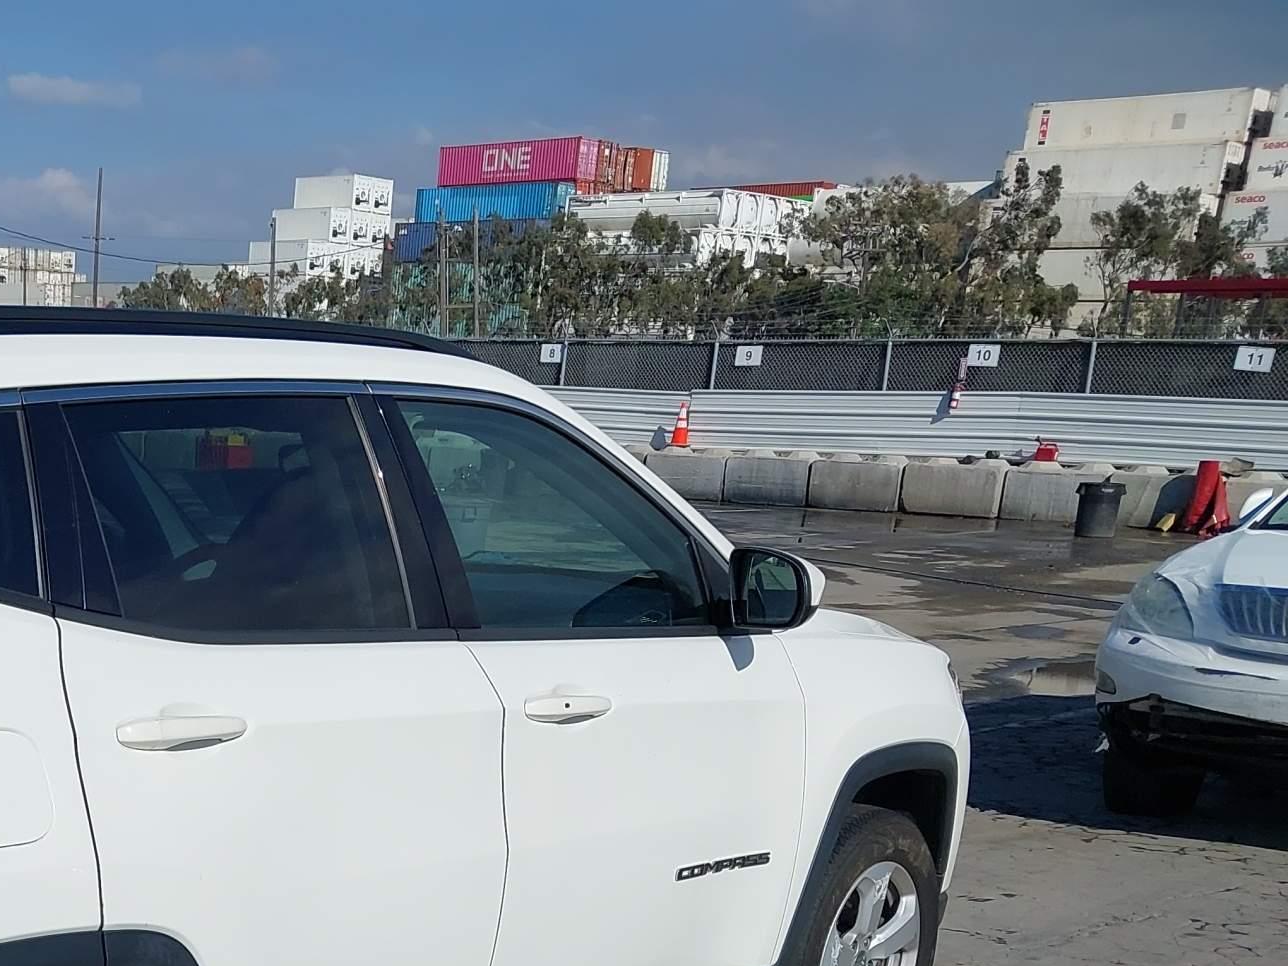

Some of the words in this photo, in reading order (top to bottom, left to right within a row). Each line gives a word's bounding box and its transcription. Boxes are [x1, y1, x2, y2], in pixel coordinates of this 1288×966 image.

[1263, 141, 1288, 149] seac
[482, 147, 531, 172] ONE
[1235, 195, 1265, 203] seaco
[549, 348, 555, 358] 8
[745, 350, 753, 361] 9
[976, 349, 991, 361] 10
[1248, 352, 1263, 366] 11
[674, 852, 770, 881] COMPASS
